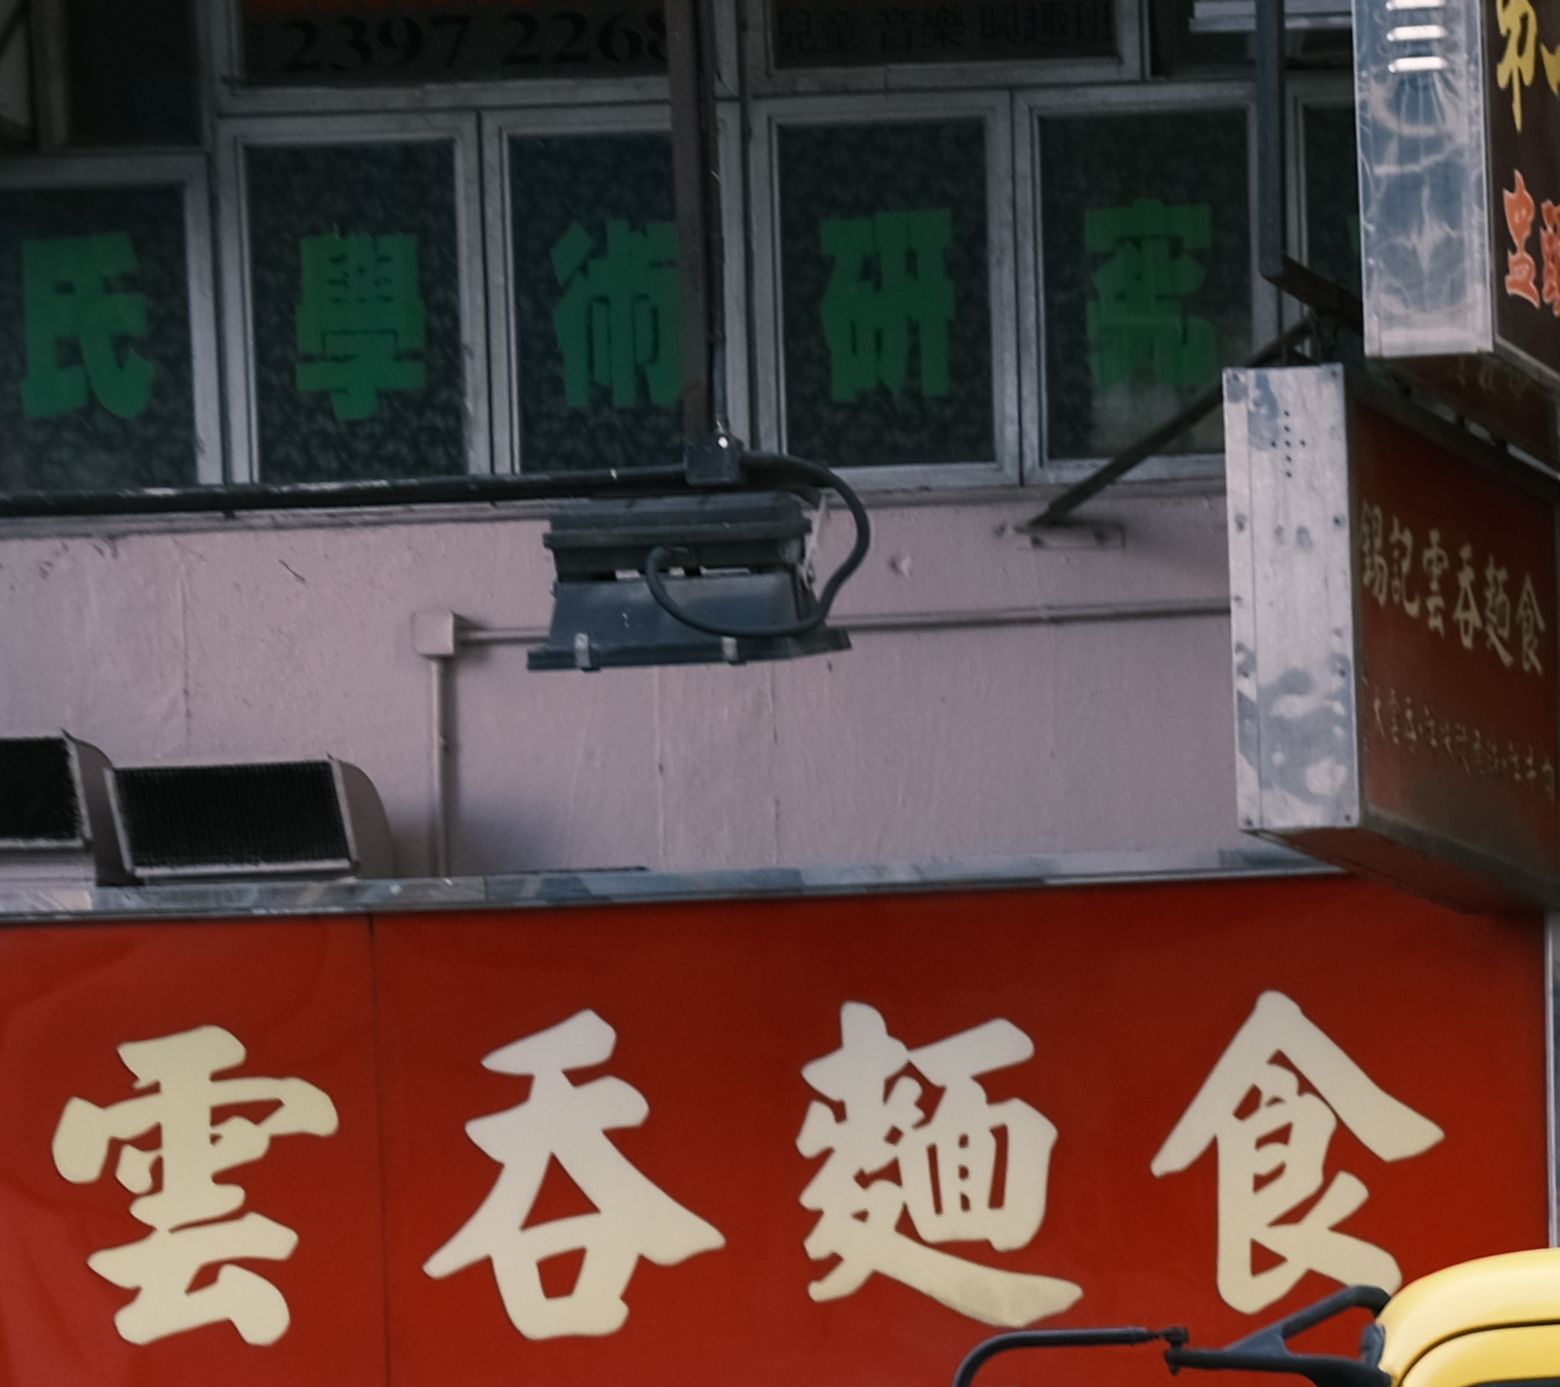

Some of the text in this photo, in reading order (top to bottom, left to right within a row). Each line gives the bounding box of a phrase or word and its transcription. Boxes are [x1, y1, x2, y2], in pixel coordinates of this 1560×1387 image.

[278, 10, 474, 74] 2397
[1360, 499, 1548, 679] 錫記雲吞麵食
[50, 988, 1447, 1348] 雲吞麵食
